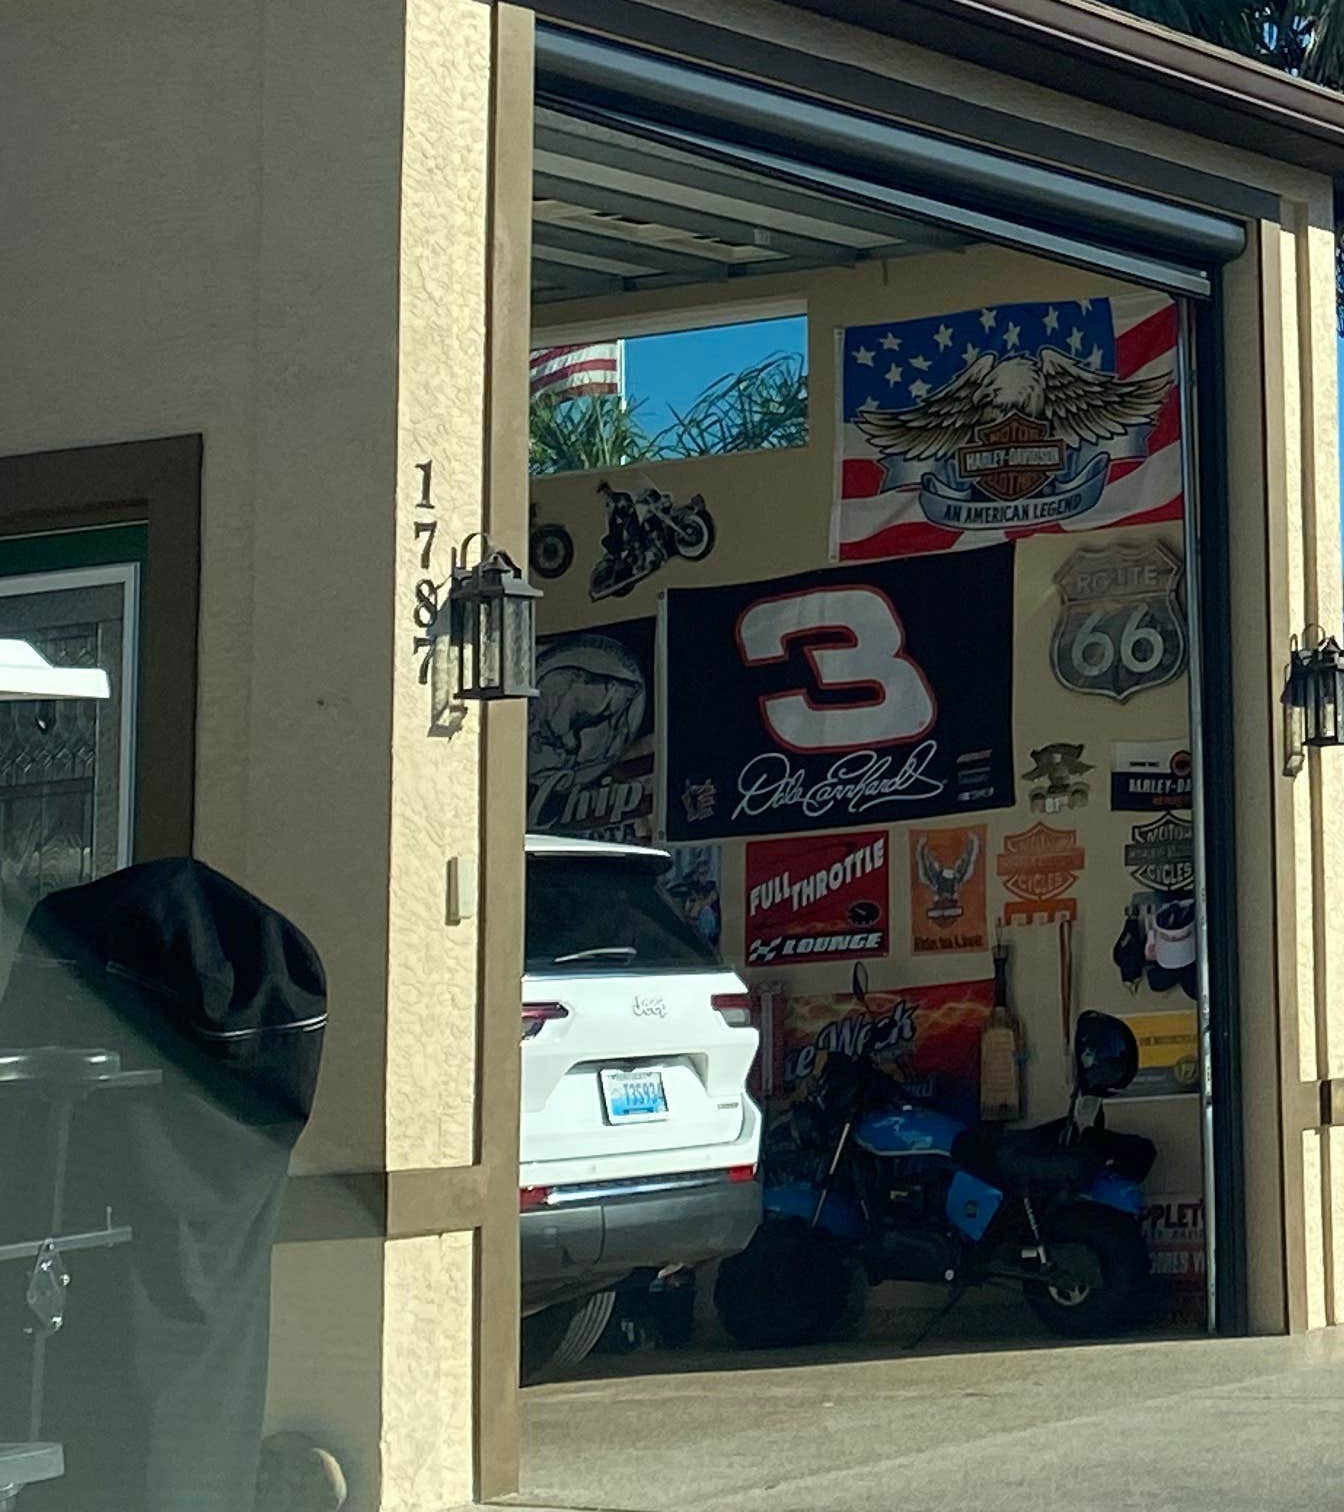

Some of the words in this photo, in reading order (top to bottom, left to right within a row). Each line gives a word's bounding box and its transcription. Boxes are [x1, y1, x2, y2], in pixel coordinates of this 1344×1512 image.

[944, 504, 962, 522] AN
[965, 505, 1029, 524] AMERICAN
[1033, 493, 1083, 520] LEGEND
[413, 459, 438, 685] 1787
[1076, 566, 1159, 593] ROUTE
[735, 584, 937, 754] 3
[1071, 602, 1164, 677] 66
[528, 768, 643, 830] Chip
[750, 871, 791, 917] FULL
[790, 838, 885, 913] THROTTLE
[1146, 863, 1193, 885] CYCLES
[782, 931, 883, 956] LOUNGE
